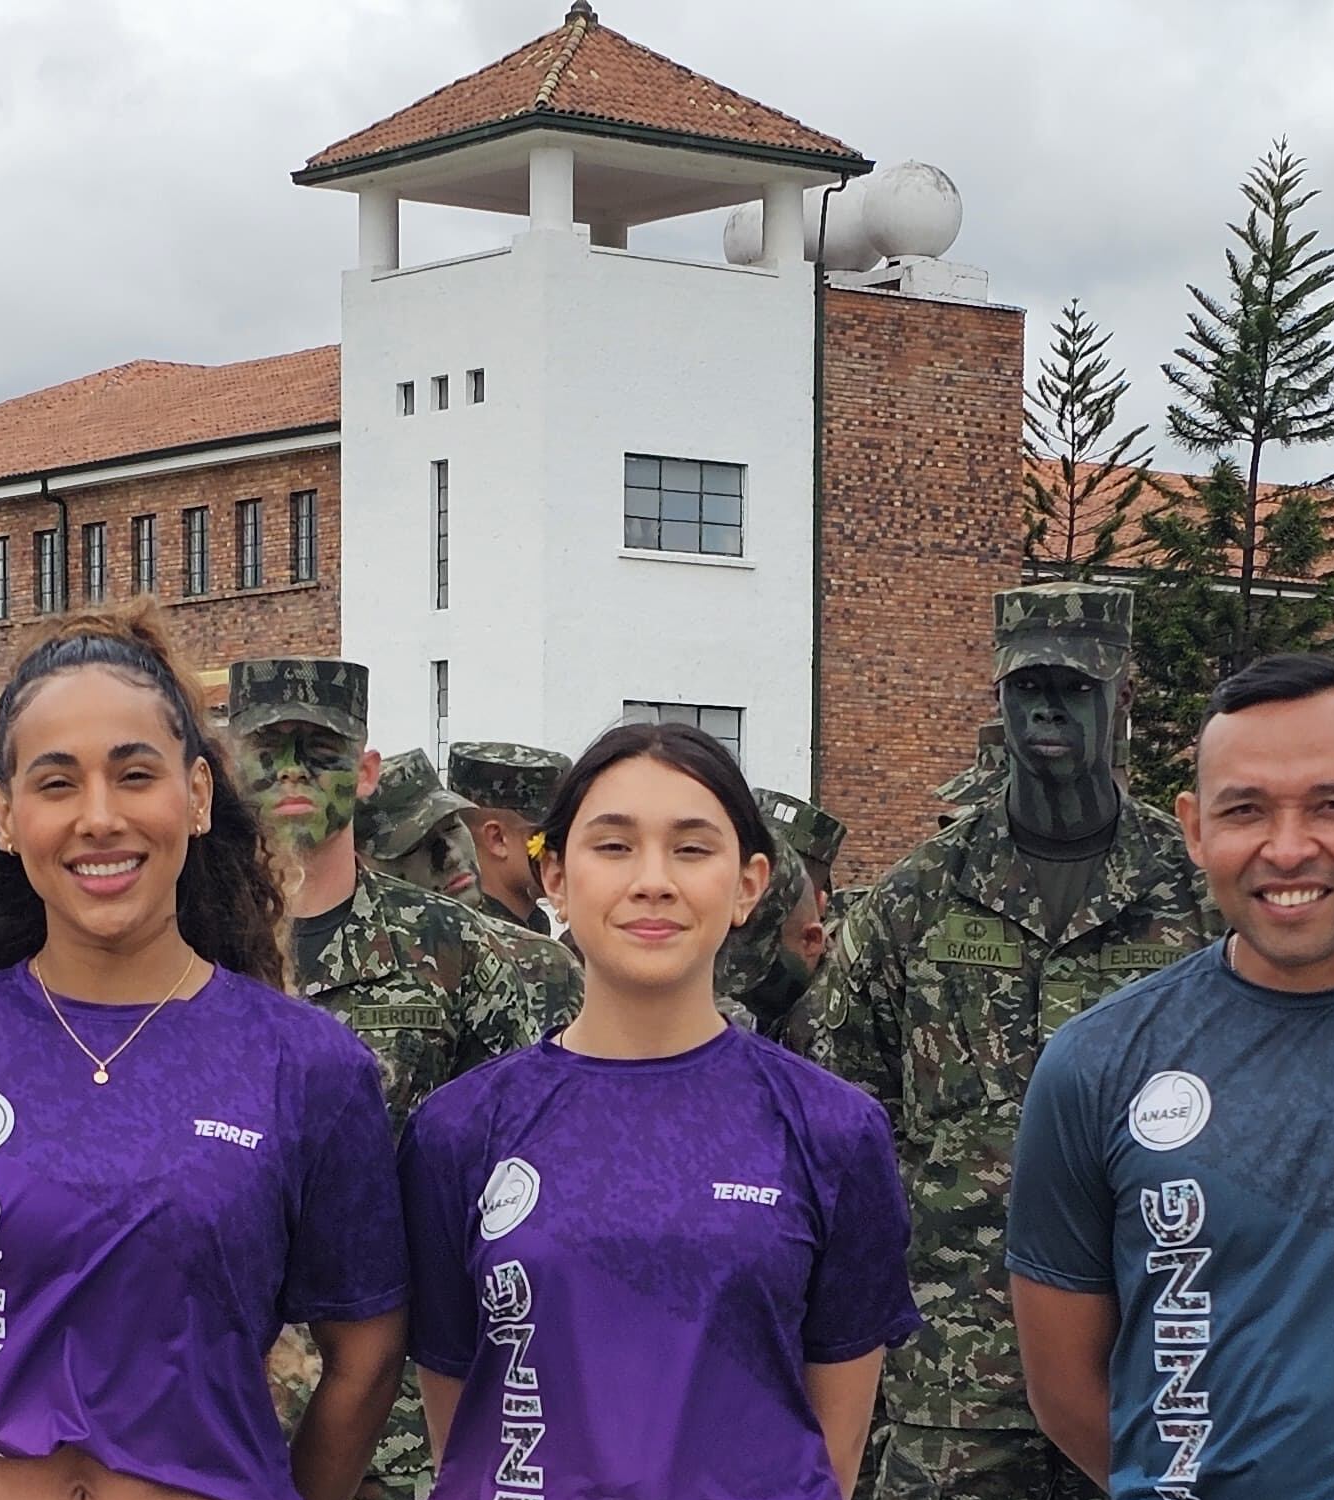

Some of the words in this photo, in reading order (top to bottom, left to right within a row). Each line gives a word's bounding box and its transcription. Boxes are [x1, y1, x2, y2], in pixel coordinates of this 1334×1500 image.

[947, 943, 1003, 962] GARCIA
[357, 1009, 438, 1026] EJERCITO
[1138, 1106, 1190, 1124] ANASE
[193, 1119, 264, 1150] TERRET
[712, 1182, 782, 1206] TERRET
